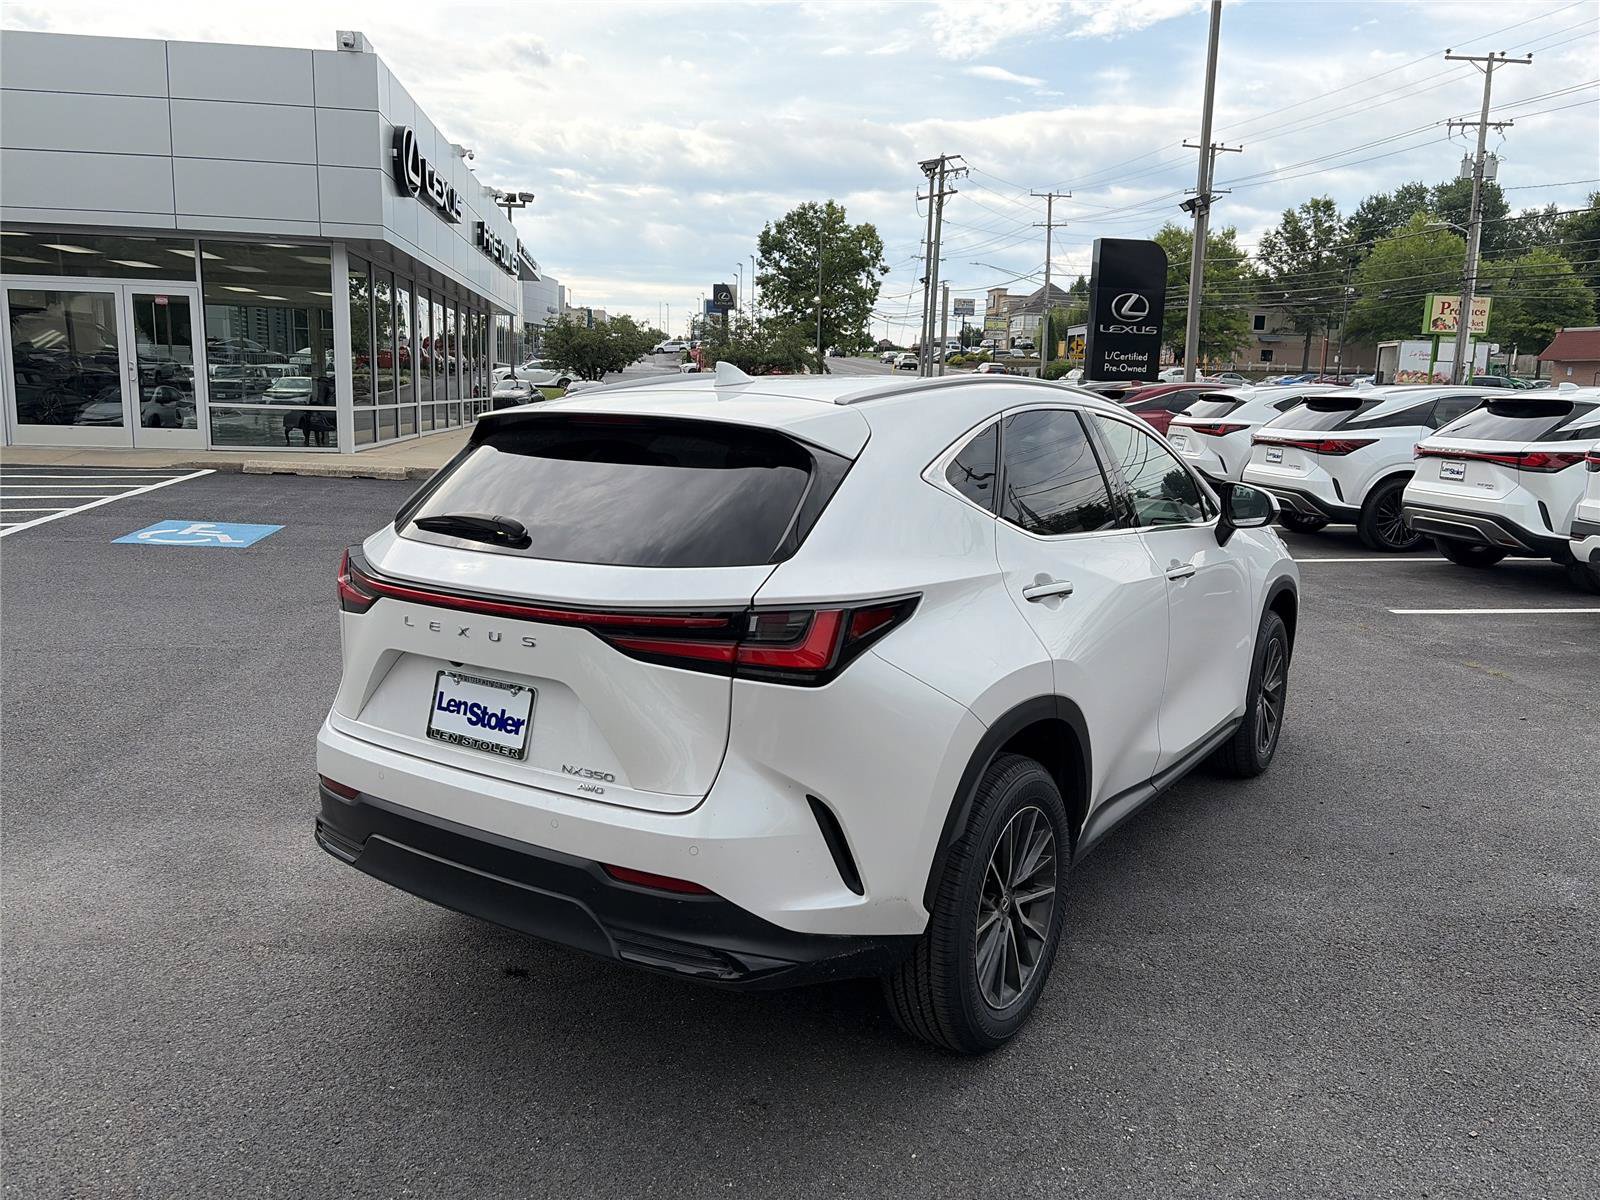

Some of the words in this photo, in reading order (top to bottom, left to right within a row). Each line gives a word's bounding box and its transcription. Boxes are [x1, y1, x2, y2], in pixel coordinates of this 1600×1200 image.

[424, 160, 462, 222] LEXUS
[1439, 301, 1486, 316] Proce
[1100, 324, 1158, 335] LEXUS
[1105, 351, 1148, 361] L/Certified
[1104, 363, 1147, 373] Pre-Owned
[404, 615, 537, 647] LEXUS
[431, 728, 458, 744] LEN
[461, 736, 519, 759] STOLER
